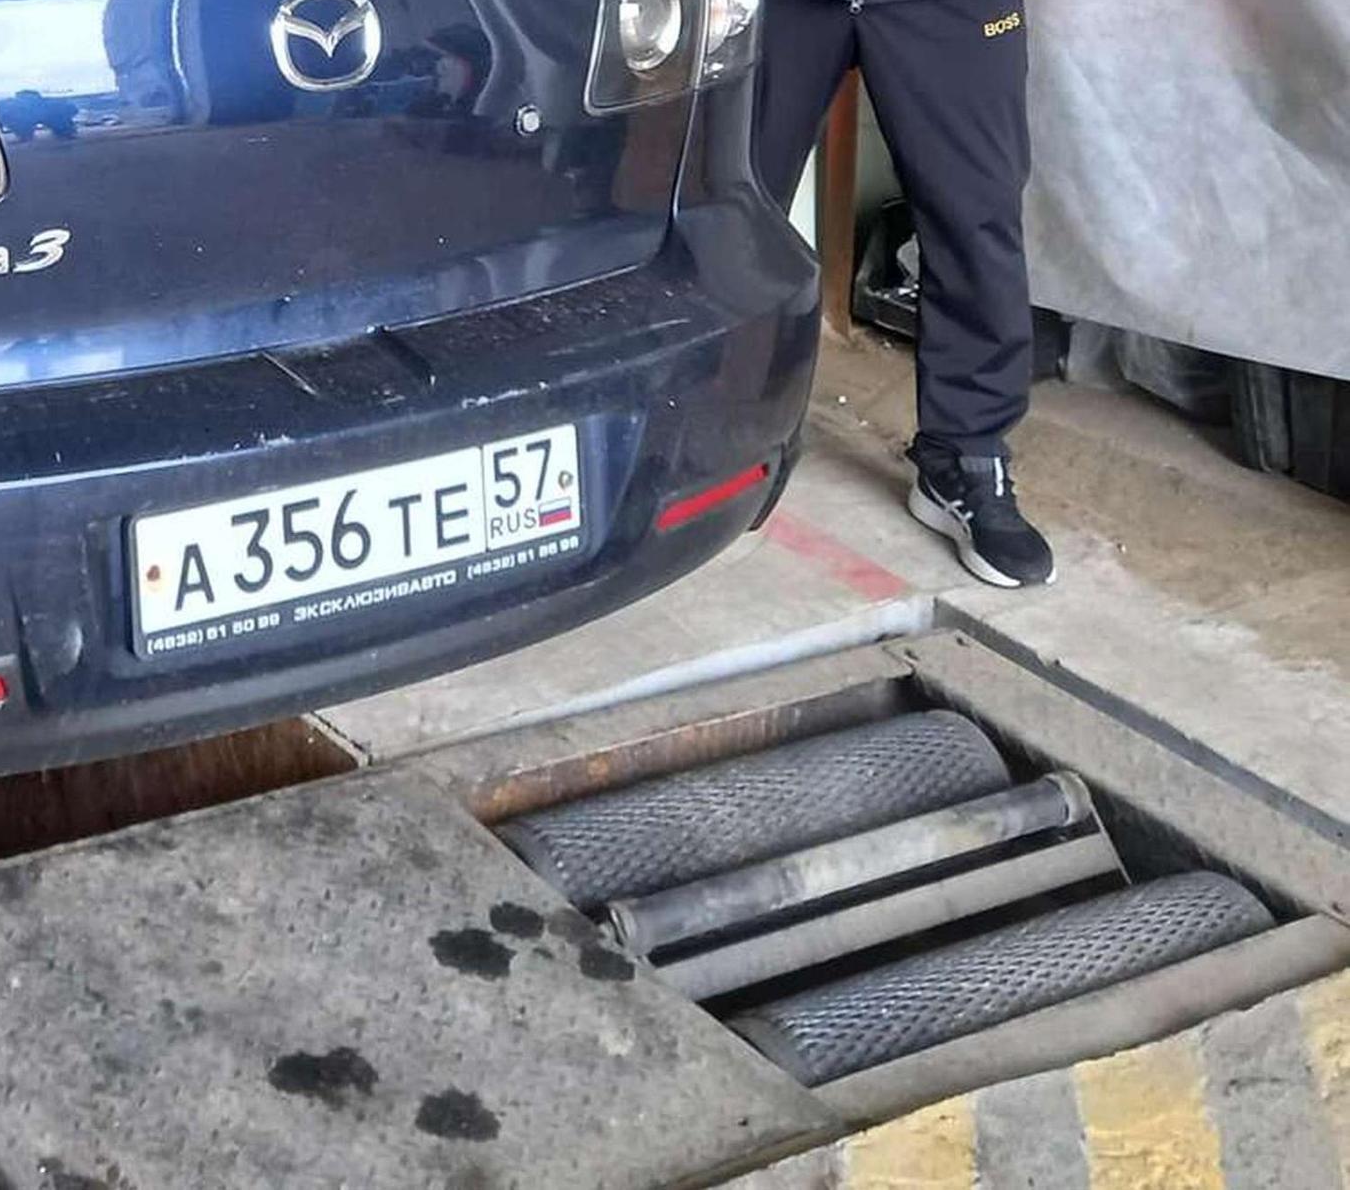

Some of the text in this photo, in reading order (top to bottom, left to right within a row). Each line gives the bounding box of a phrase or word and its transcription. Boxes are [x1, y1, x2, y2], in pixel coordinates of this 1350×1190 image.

[983, 12, 1020, 38] BOSS
[12, 228, 71, 273] 3
[493, 438, 552, 508] 57
[490, 508, 537, 539] RUS
